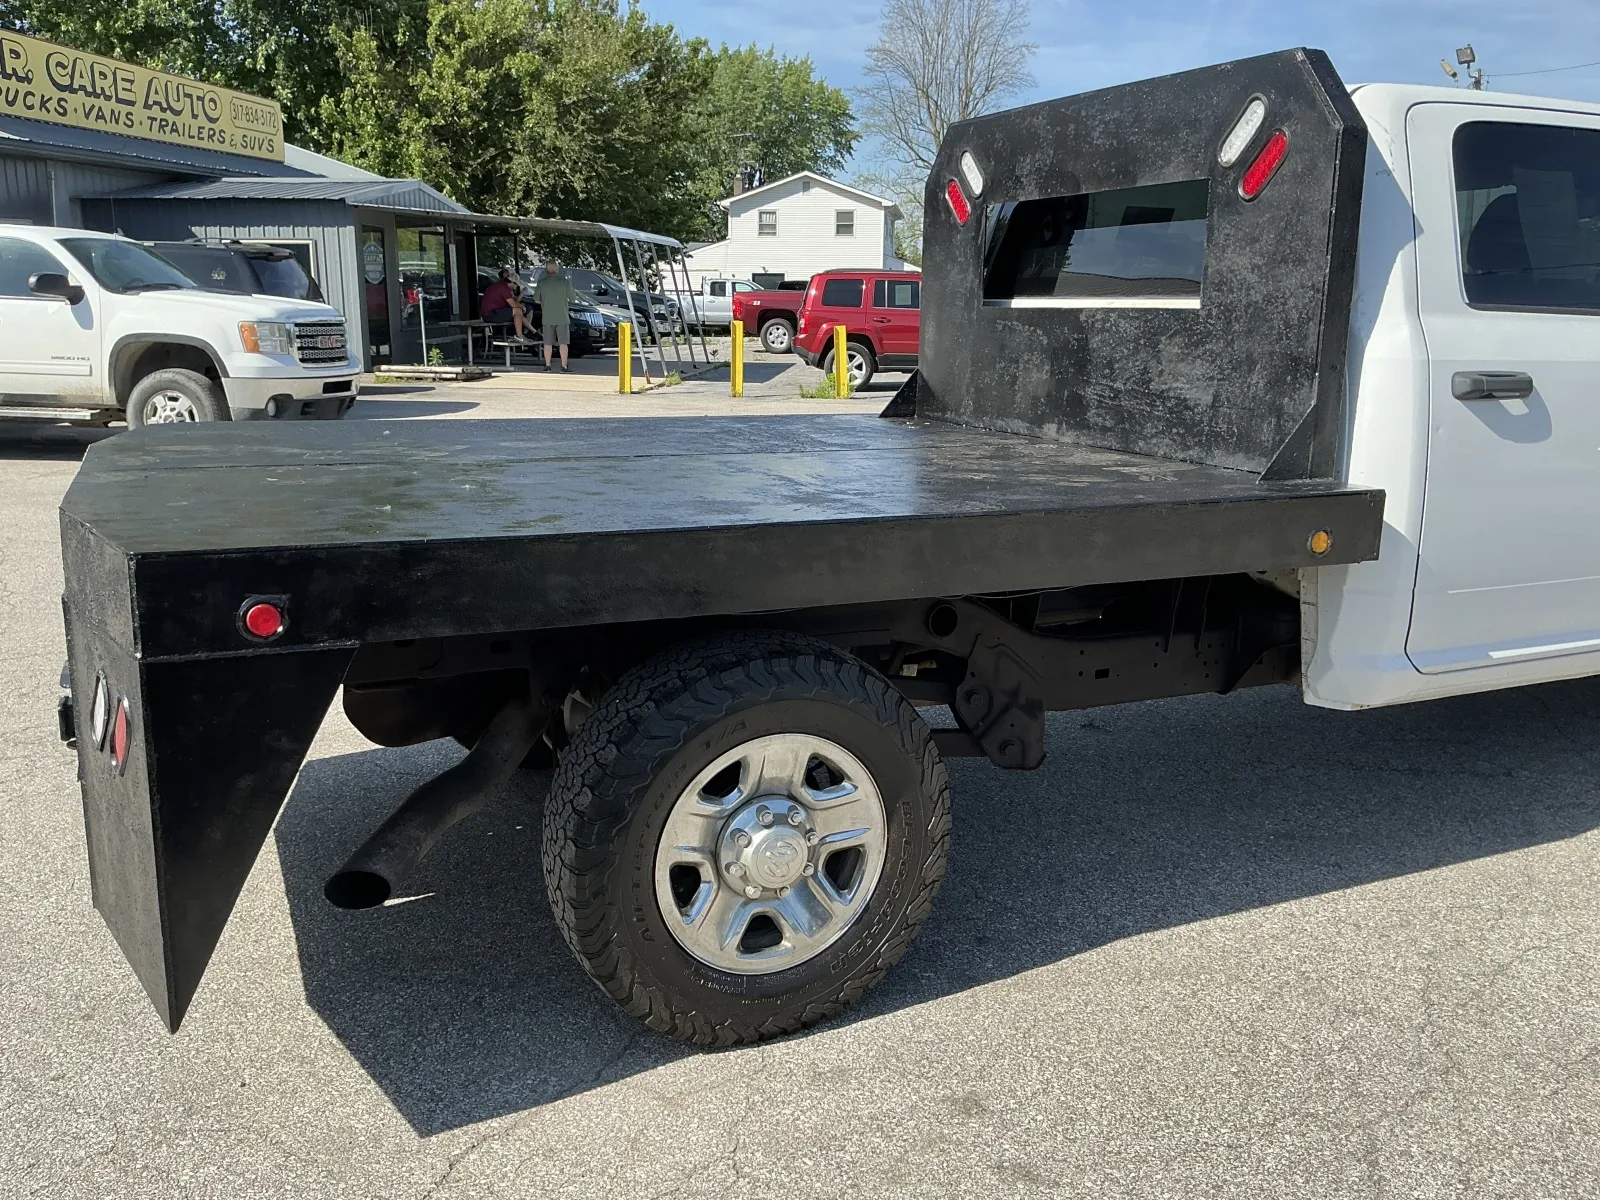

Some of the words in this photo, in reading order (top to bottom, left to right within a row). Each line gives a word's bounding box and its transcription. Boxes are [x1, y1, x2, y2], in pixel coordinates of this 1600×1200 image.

[0, 37, 34, 85] R.
[46, 51, 137, 107] CARE
[143, 77, 223, 124] AUTO
[232, 102, 276, 128] 317-834-3172
[0, 85, 68, 117] UCKS
[82, 102, 135, 129] VANS
[147, 116, 226, 145] TRAILERS
[229, 133, 237, 150] &
[240, 134, 274, 154] SUV'S
